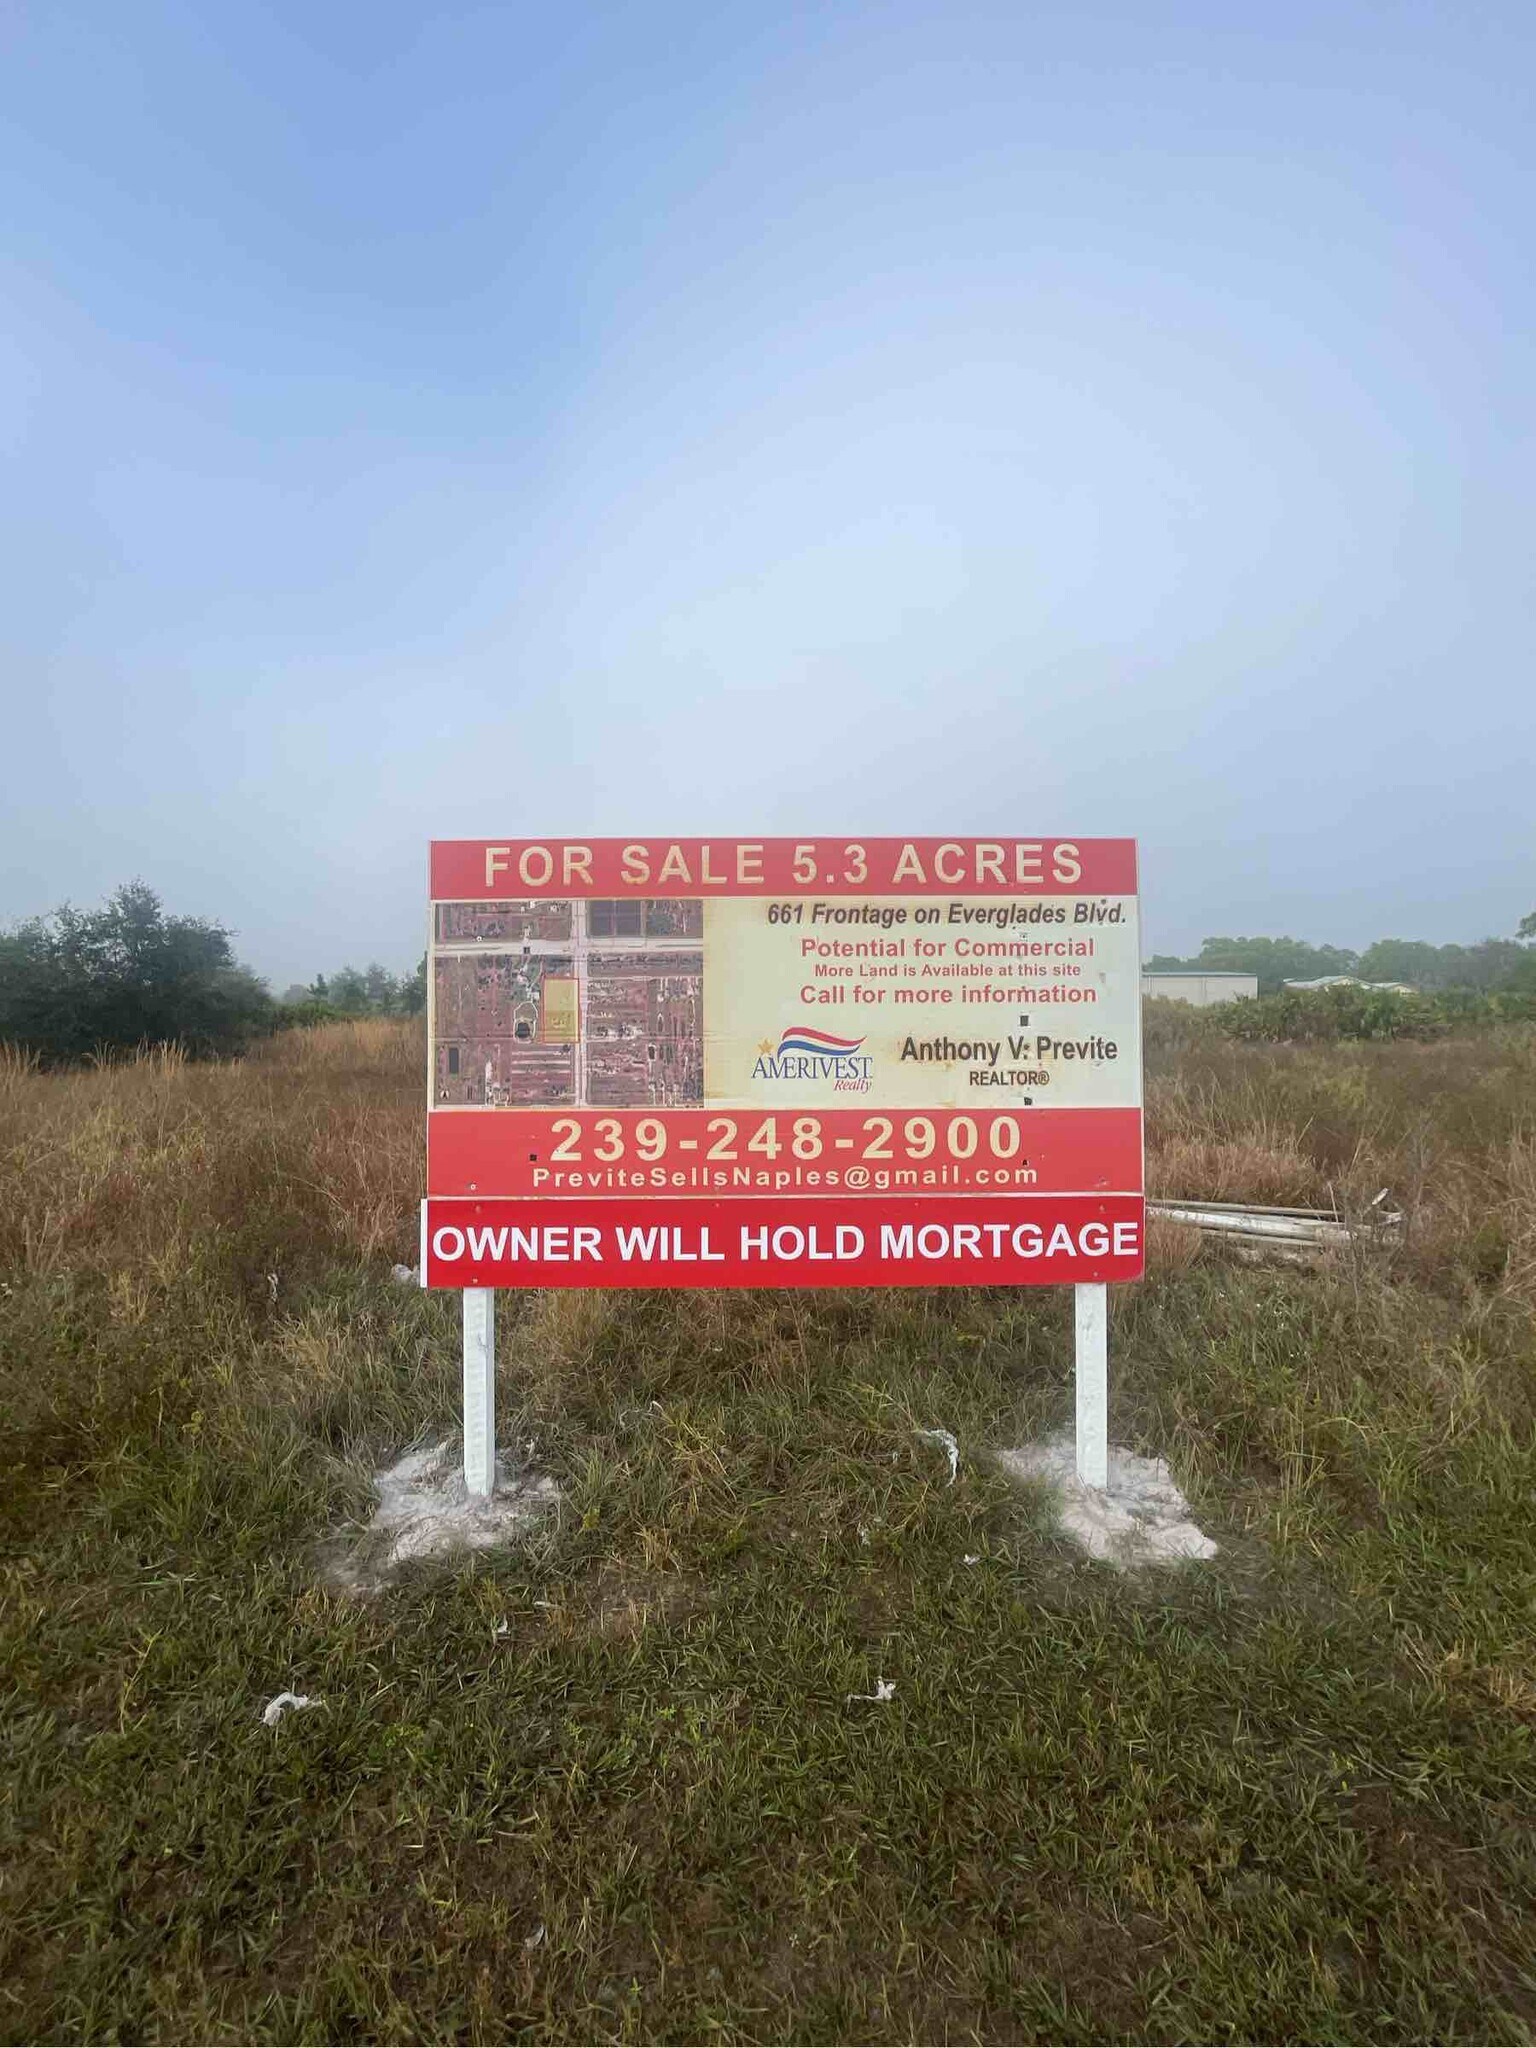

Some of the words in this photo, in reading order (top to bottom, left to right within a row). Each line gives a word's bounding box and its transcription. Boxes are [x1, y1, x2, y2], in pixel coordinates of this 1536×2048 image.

[484, 845, 593, 887] FOR
[621, 844, 765, 885] SALE
[793, 844, 868, 884] 5.3
[892, 843, 1082, 884] ACRES
[812, 903, 907, 929] Frontage
[915, 907, 940, 923] on
[948, 901, 1065, 928] Everglades
[1074, 902, 1126, 923] Blvd.
[802, 938, 905, 957] Potential
[914, 938, 946, 956] for
[954, 938, 1094, 957] Commercial
[815, 964, 853, 977] More
[860, 964, 898, 977] Land
[904, 964, 916, 977] is
[922, 963, 993, 977] Available
[999, 964, 1013, 976] at
[1018, 963, 1046, 976] this
[1053, 963, 1081, 976] site
[801, 984, 845, 1004] Call
[853, 984, 886, 1003] for
[895, 989, 952, 1003] more
[962, 984, 1096, 1003] information
[901, 1036, 1000, 1066] Anthony
[1037, 1036, 1118, 1060] Previte
[751, 1056, 873, 1079] AMERIVEST
[833, 1078, 872, 1093] Realty
[550, 1116, 1021, 1162] 239-248-2900
[532, 1165, 1038, 1190] PreviteSellsNaples@gmail.com
[432, 1227, 603, 1262] OWNER
[616, 1227, 725, 1261] WILL
[740, 1225, 865, 1261] HOLD
[880, 1222, 1140, 1260] MORTGAGE
